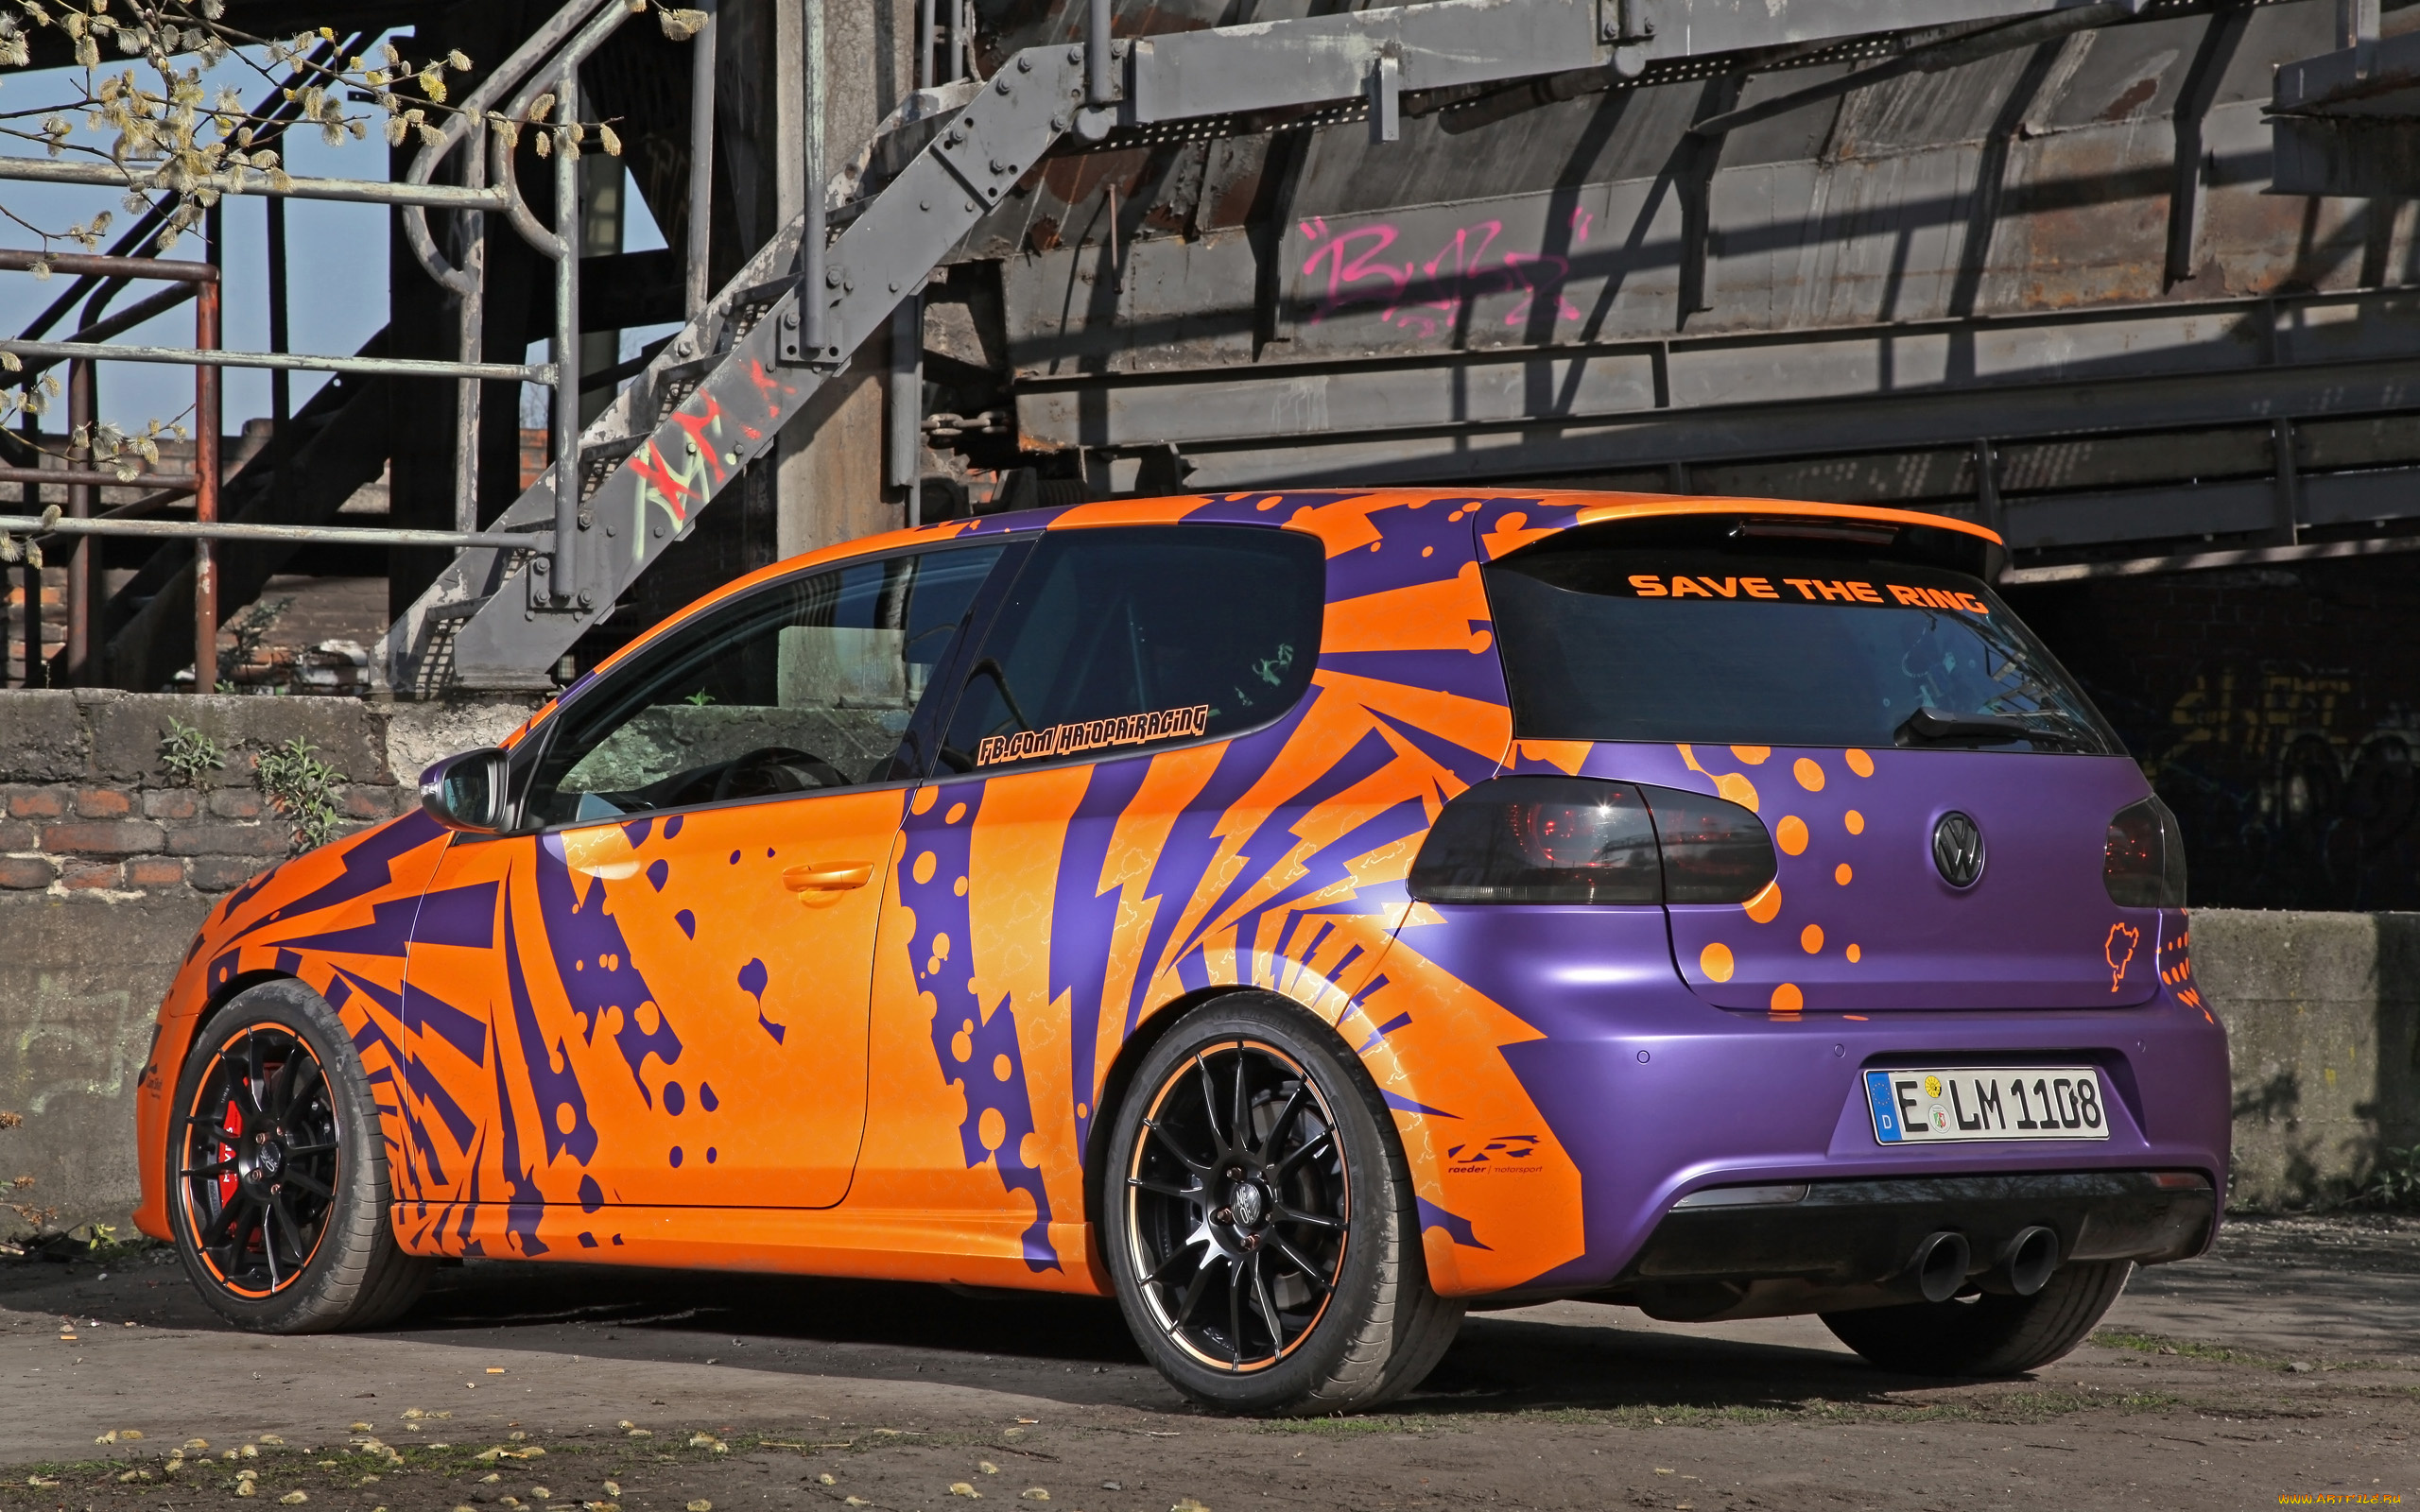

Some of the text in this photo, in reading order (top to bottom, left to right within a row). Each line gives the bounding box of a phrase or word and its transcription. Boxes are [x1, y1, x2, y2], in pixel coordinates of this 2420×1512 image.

[1628, 575, 1989, 613] SAVE THE RING
[1894, 1080, 1929, 1132] E
[1948, 1079, 2007, 1130] LM
[2010, 1078, 2101, 1129] 1108
[1882, 1114, 1892, 1129] D
[1448, 1165, 1486, 1174] raeder
